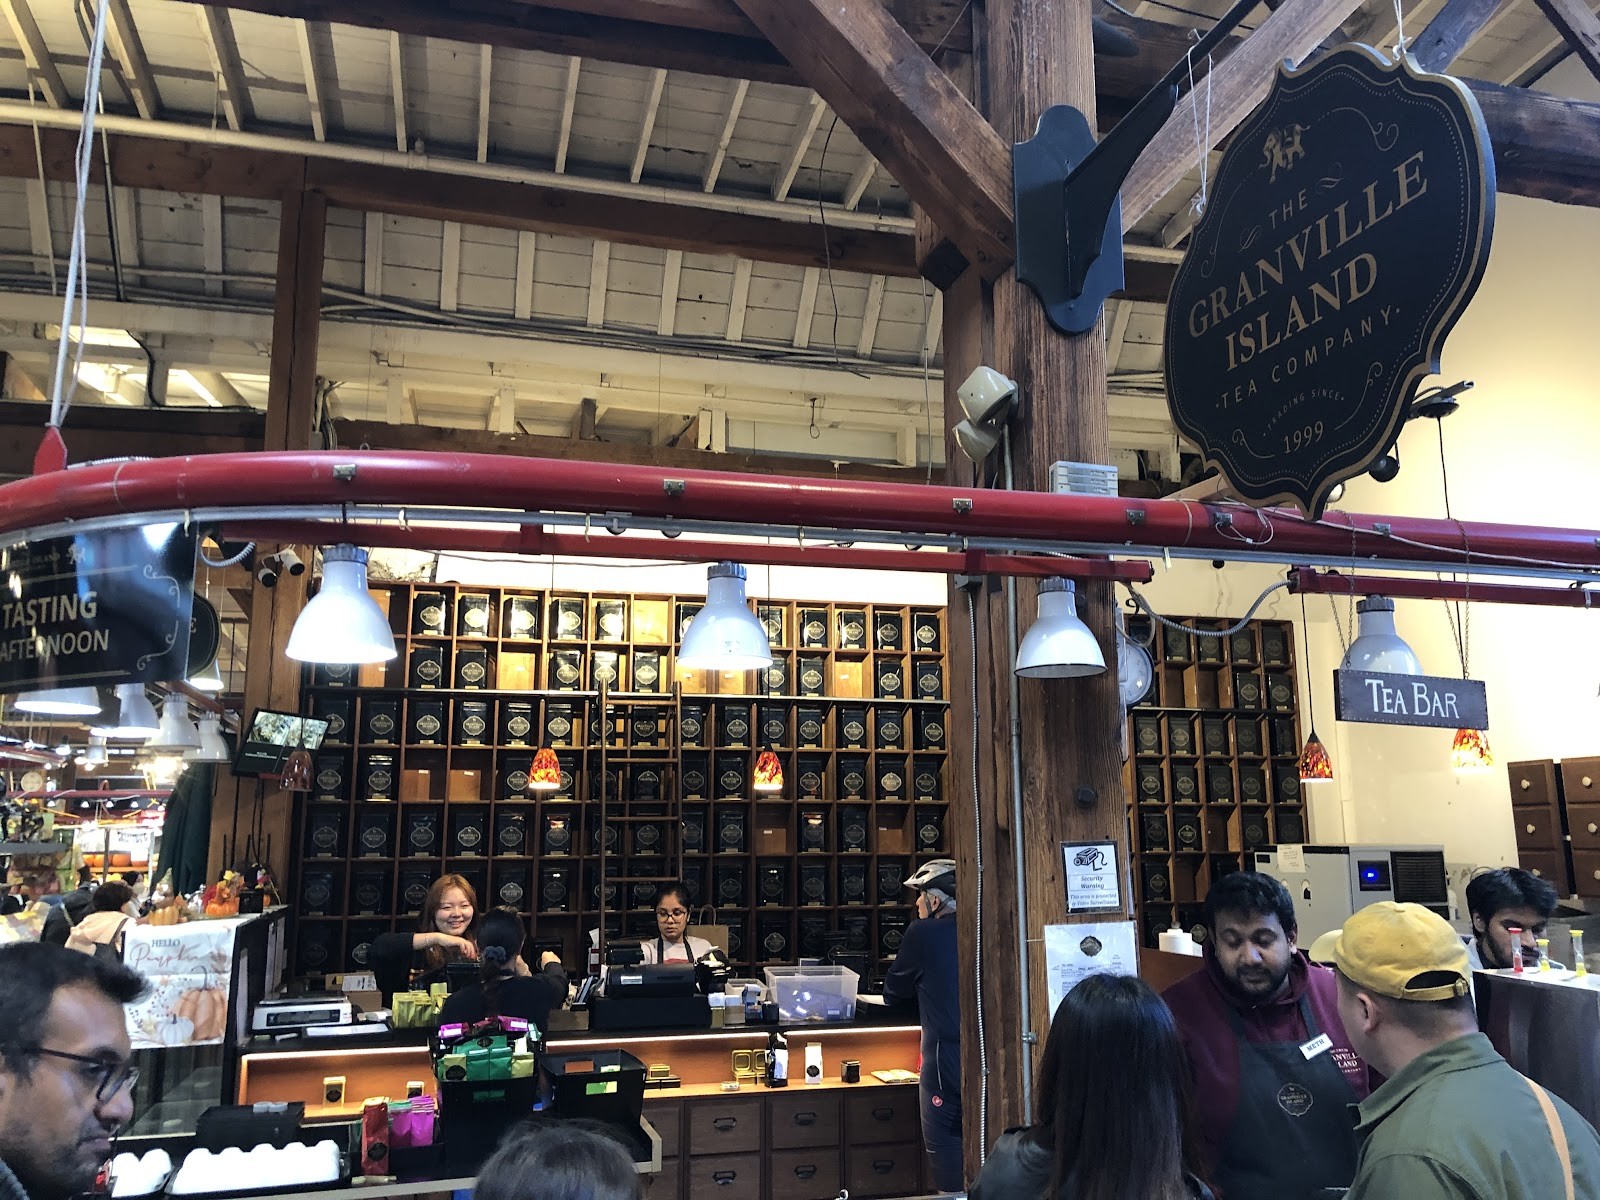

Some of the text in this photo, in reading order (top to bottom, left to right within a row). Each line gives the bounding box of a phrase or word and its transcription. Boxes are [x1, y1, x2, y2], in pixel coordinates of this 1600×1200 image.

[1269, 188, 1308, 229] THE
[1188, 150, 1428, 339] GRANVILLE
[1225, 252, 1378, 373] ISLAND
[1221, 311, 1390, 410] TEA COMPANY
[1266, 393, 1305, 431] TRADING
[1283, 420, 1324, 454] 1999
[3, 591, 97, 630] TASTING
[0, 629, 110, 663] AFTERNOON
[152, 939, 180, 948] HELLO
